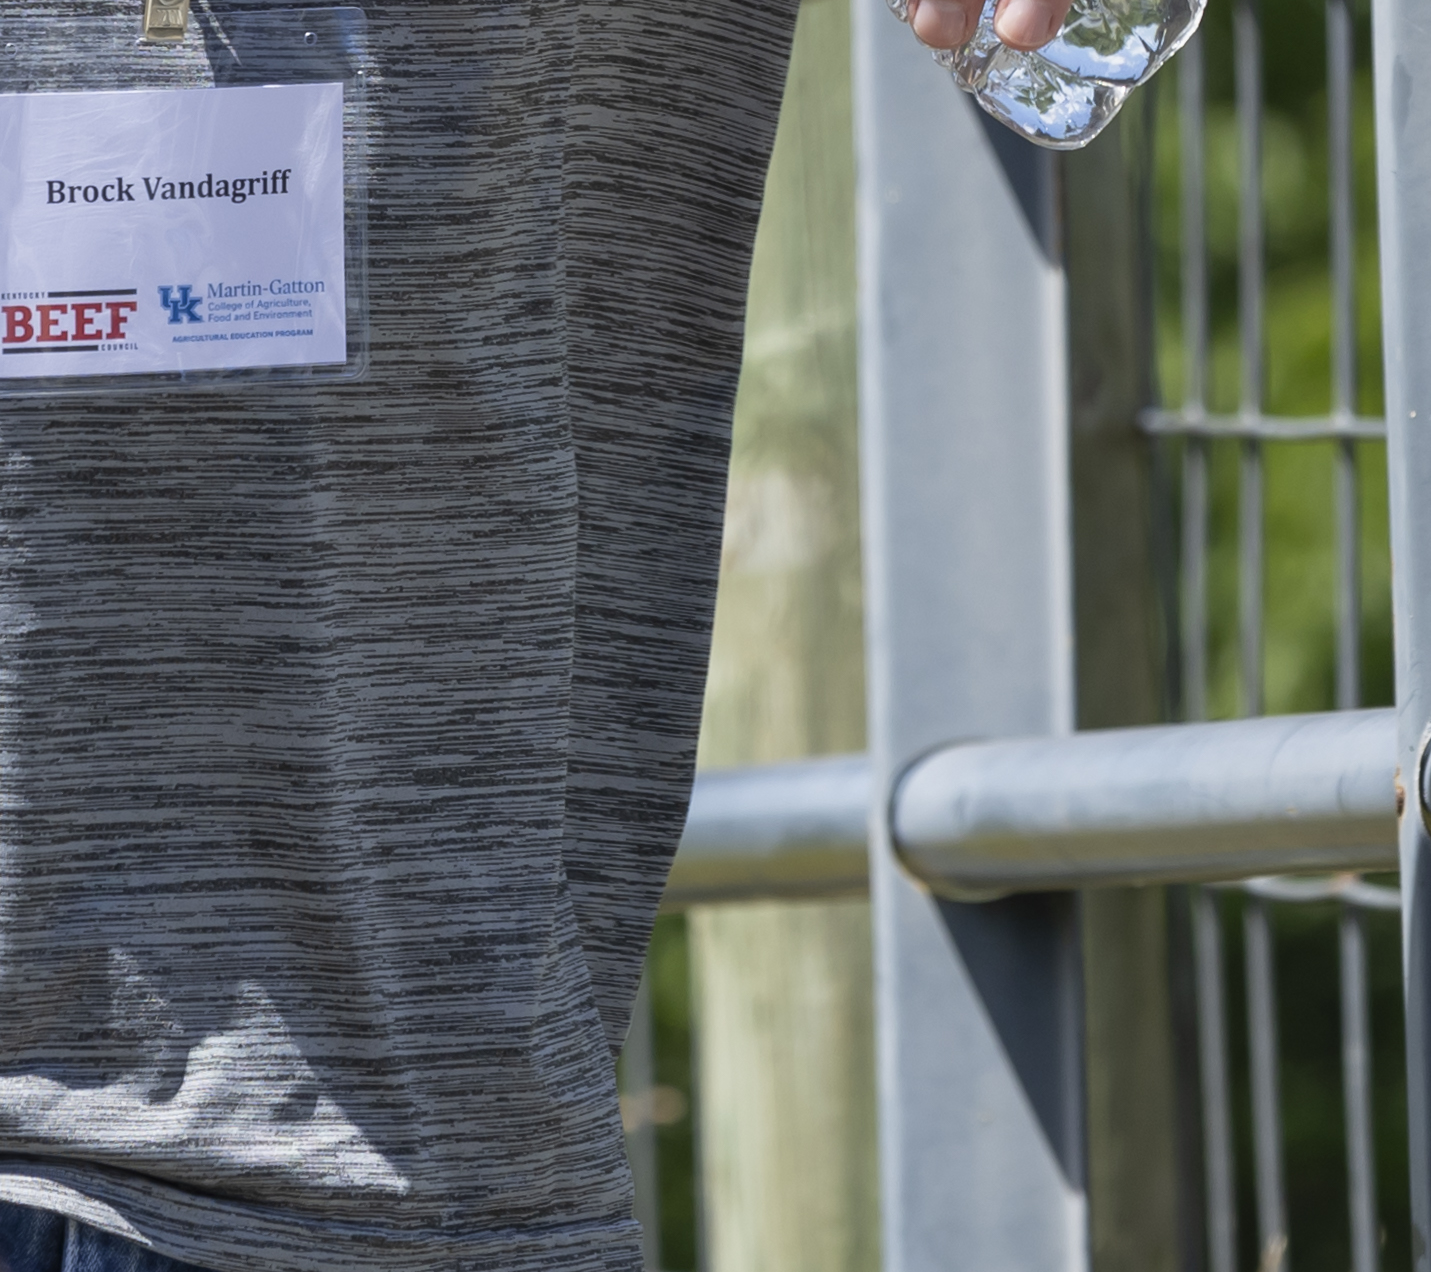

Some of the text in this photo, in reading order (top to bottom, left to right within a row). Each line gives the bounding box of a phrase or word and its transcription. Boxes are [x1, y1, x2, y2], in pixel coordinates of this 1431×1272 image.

[45, 168, 292, 205] Brock Vandagriff
[207, 278, 326, 299] Martin-Gatton
[1, 292, 46, 301] KENTUCKY
[208, 297, 312, 312] College of Agriculture,
[1, 301, 138, 344] BEEF
[208, 308, 313, 323] Food and Environment
[172, 328, 314, 343] AGRICULTURAL EDUCATION PROGRAM
[101, 342, 139, 352] COUNCIL
